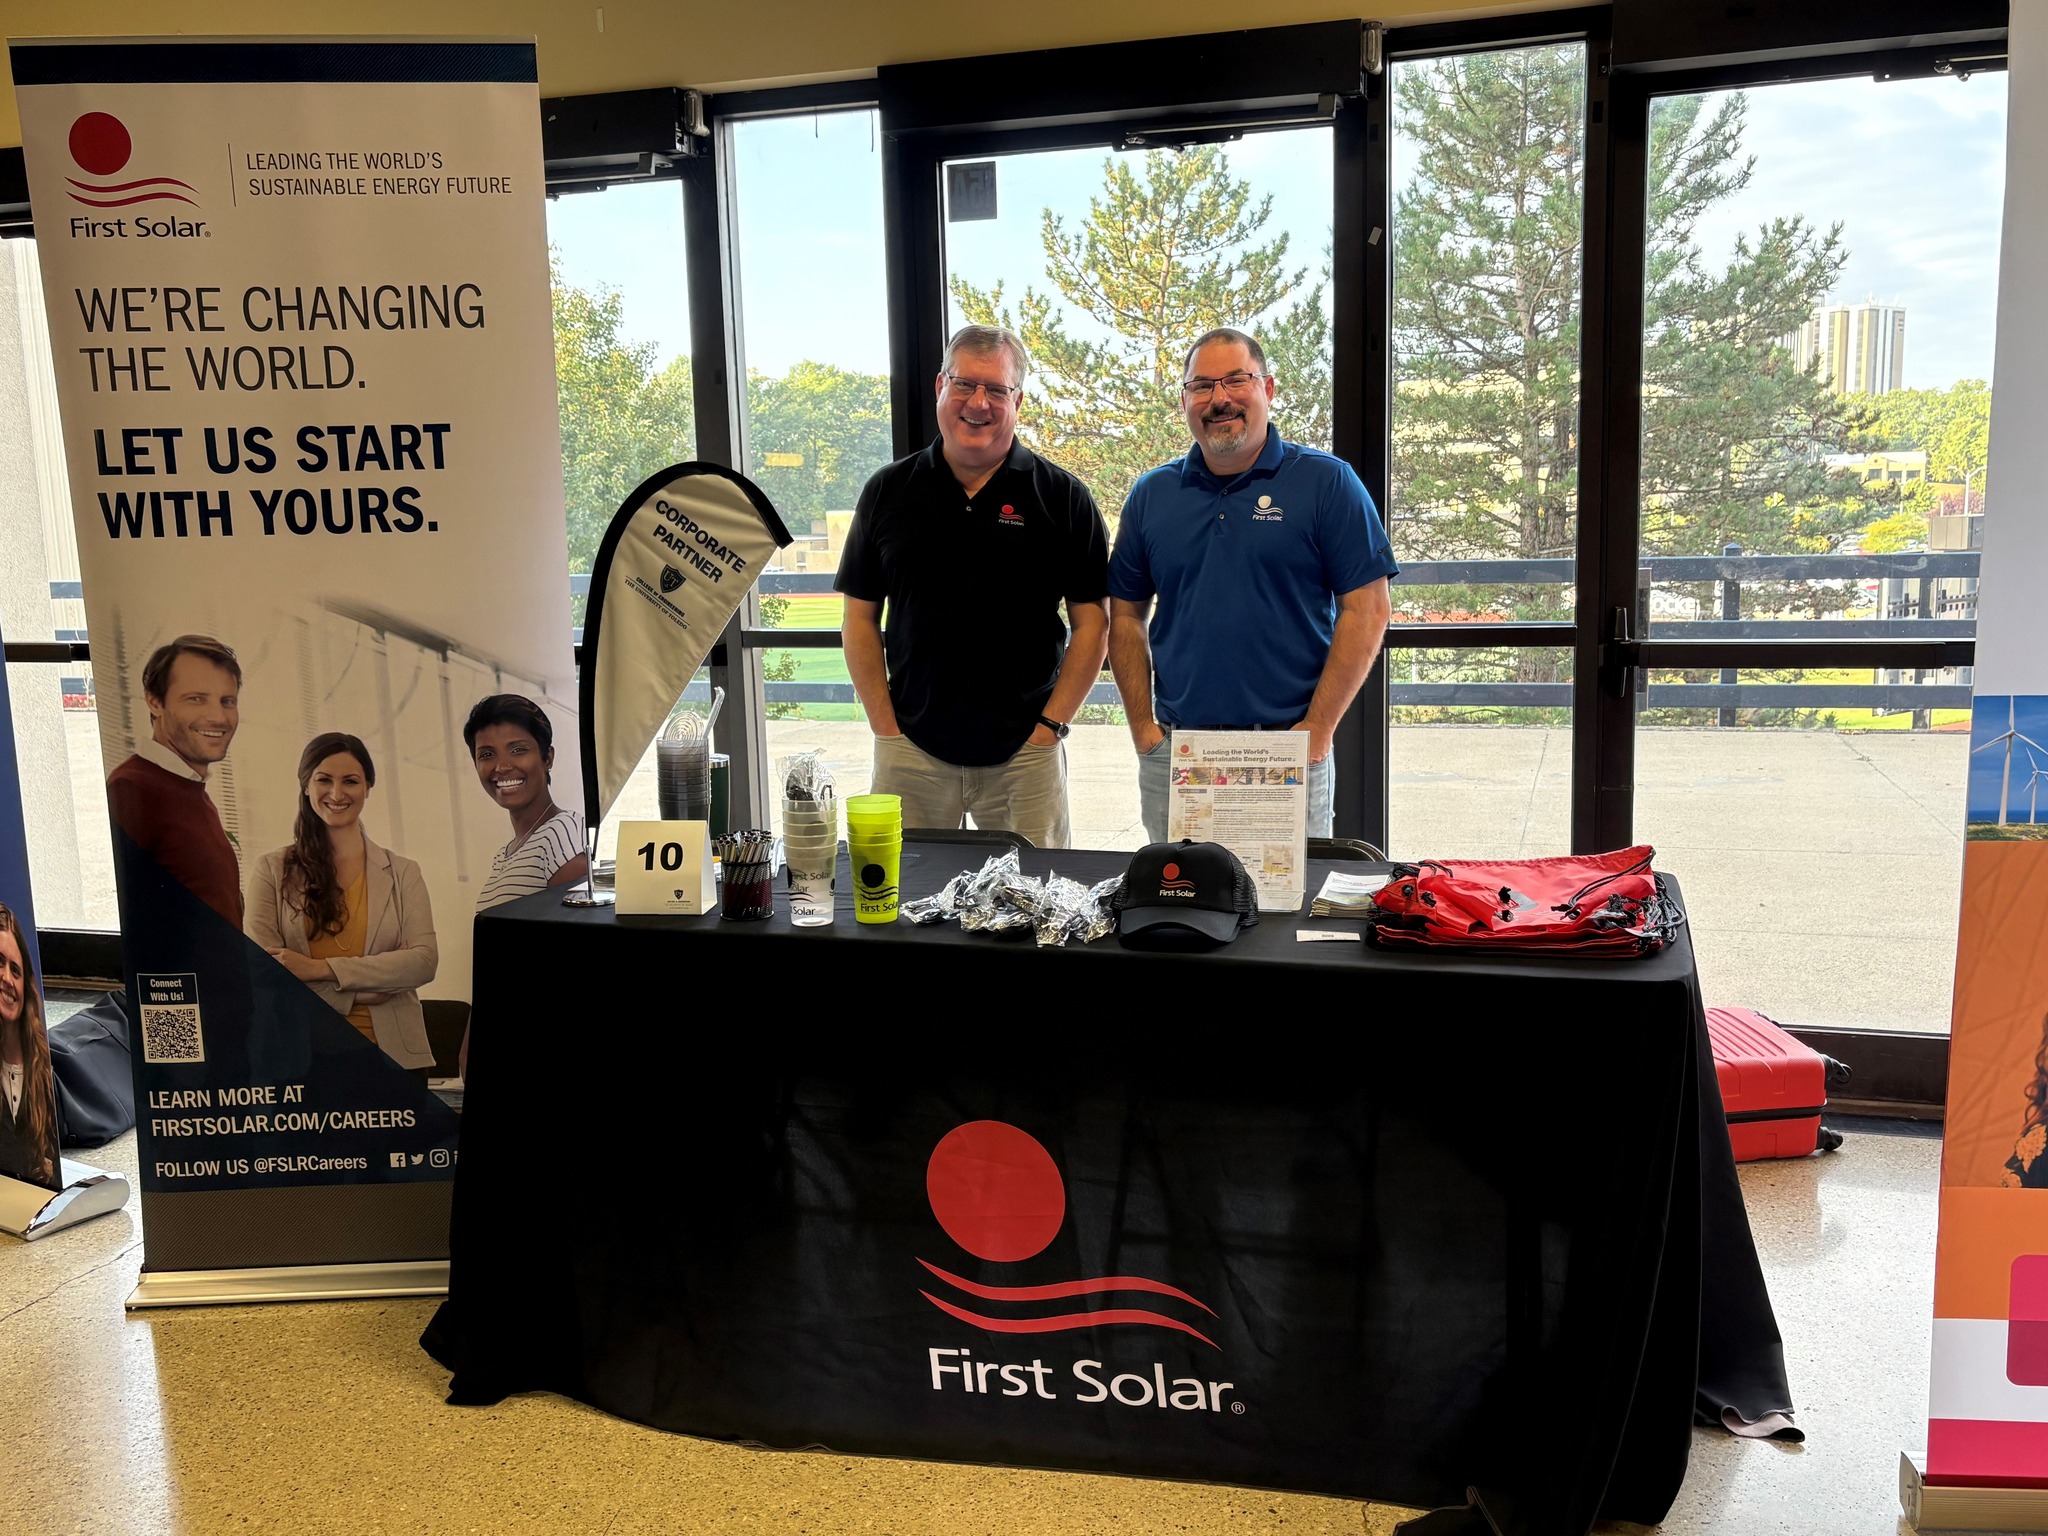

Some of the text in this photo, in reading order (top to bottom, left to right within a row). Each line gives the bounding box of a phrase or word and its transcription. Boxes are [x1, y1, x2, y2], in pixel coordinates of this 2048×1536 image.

[246, 151, 443, 170] LEADING THE WORLD'S
[249, 176, 512, 195] SUSTAINABLE ENERGY FUTURE
[70, 216, 128, 238] First
[74, 283, 486, 333] WE'RE CHANGING
[79, 345, 366, 392] THE WORLD.
[93, 423, 451, 476] LET US START
[97, 486, 439, 539] WITH YOURS.
[655, 500, 747, 574] CORPORATE
[652, 523, 723, 584] PARTNER
[664, 570, 679, 587] UT
[624, 579, 688, 630] THE UNIVERSITY OF TOLEDO
[637, 842, 684, 871] 10
[860, 900, 898, 912] First Sola
[1176, 890, 1196, 898] Solar
[793, 906, 816, 916] Solar
[149, 978, 183, 988] Connect
[150, 991, 185, 1001] With Us!
[149, 1085, 305, 1109] LEARN MORE AT
[151, 1108, 417, 1138] FIRSTSOLAR.COM/CAREERS
[155, 1154, 368, 1178] FOLLOW US @FSLRCareers
[928, 1346, 1057, 1400] First
